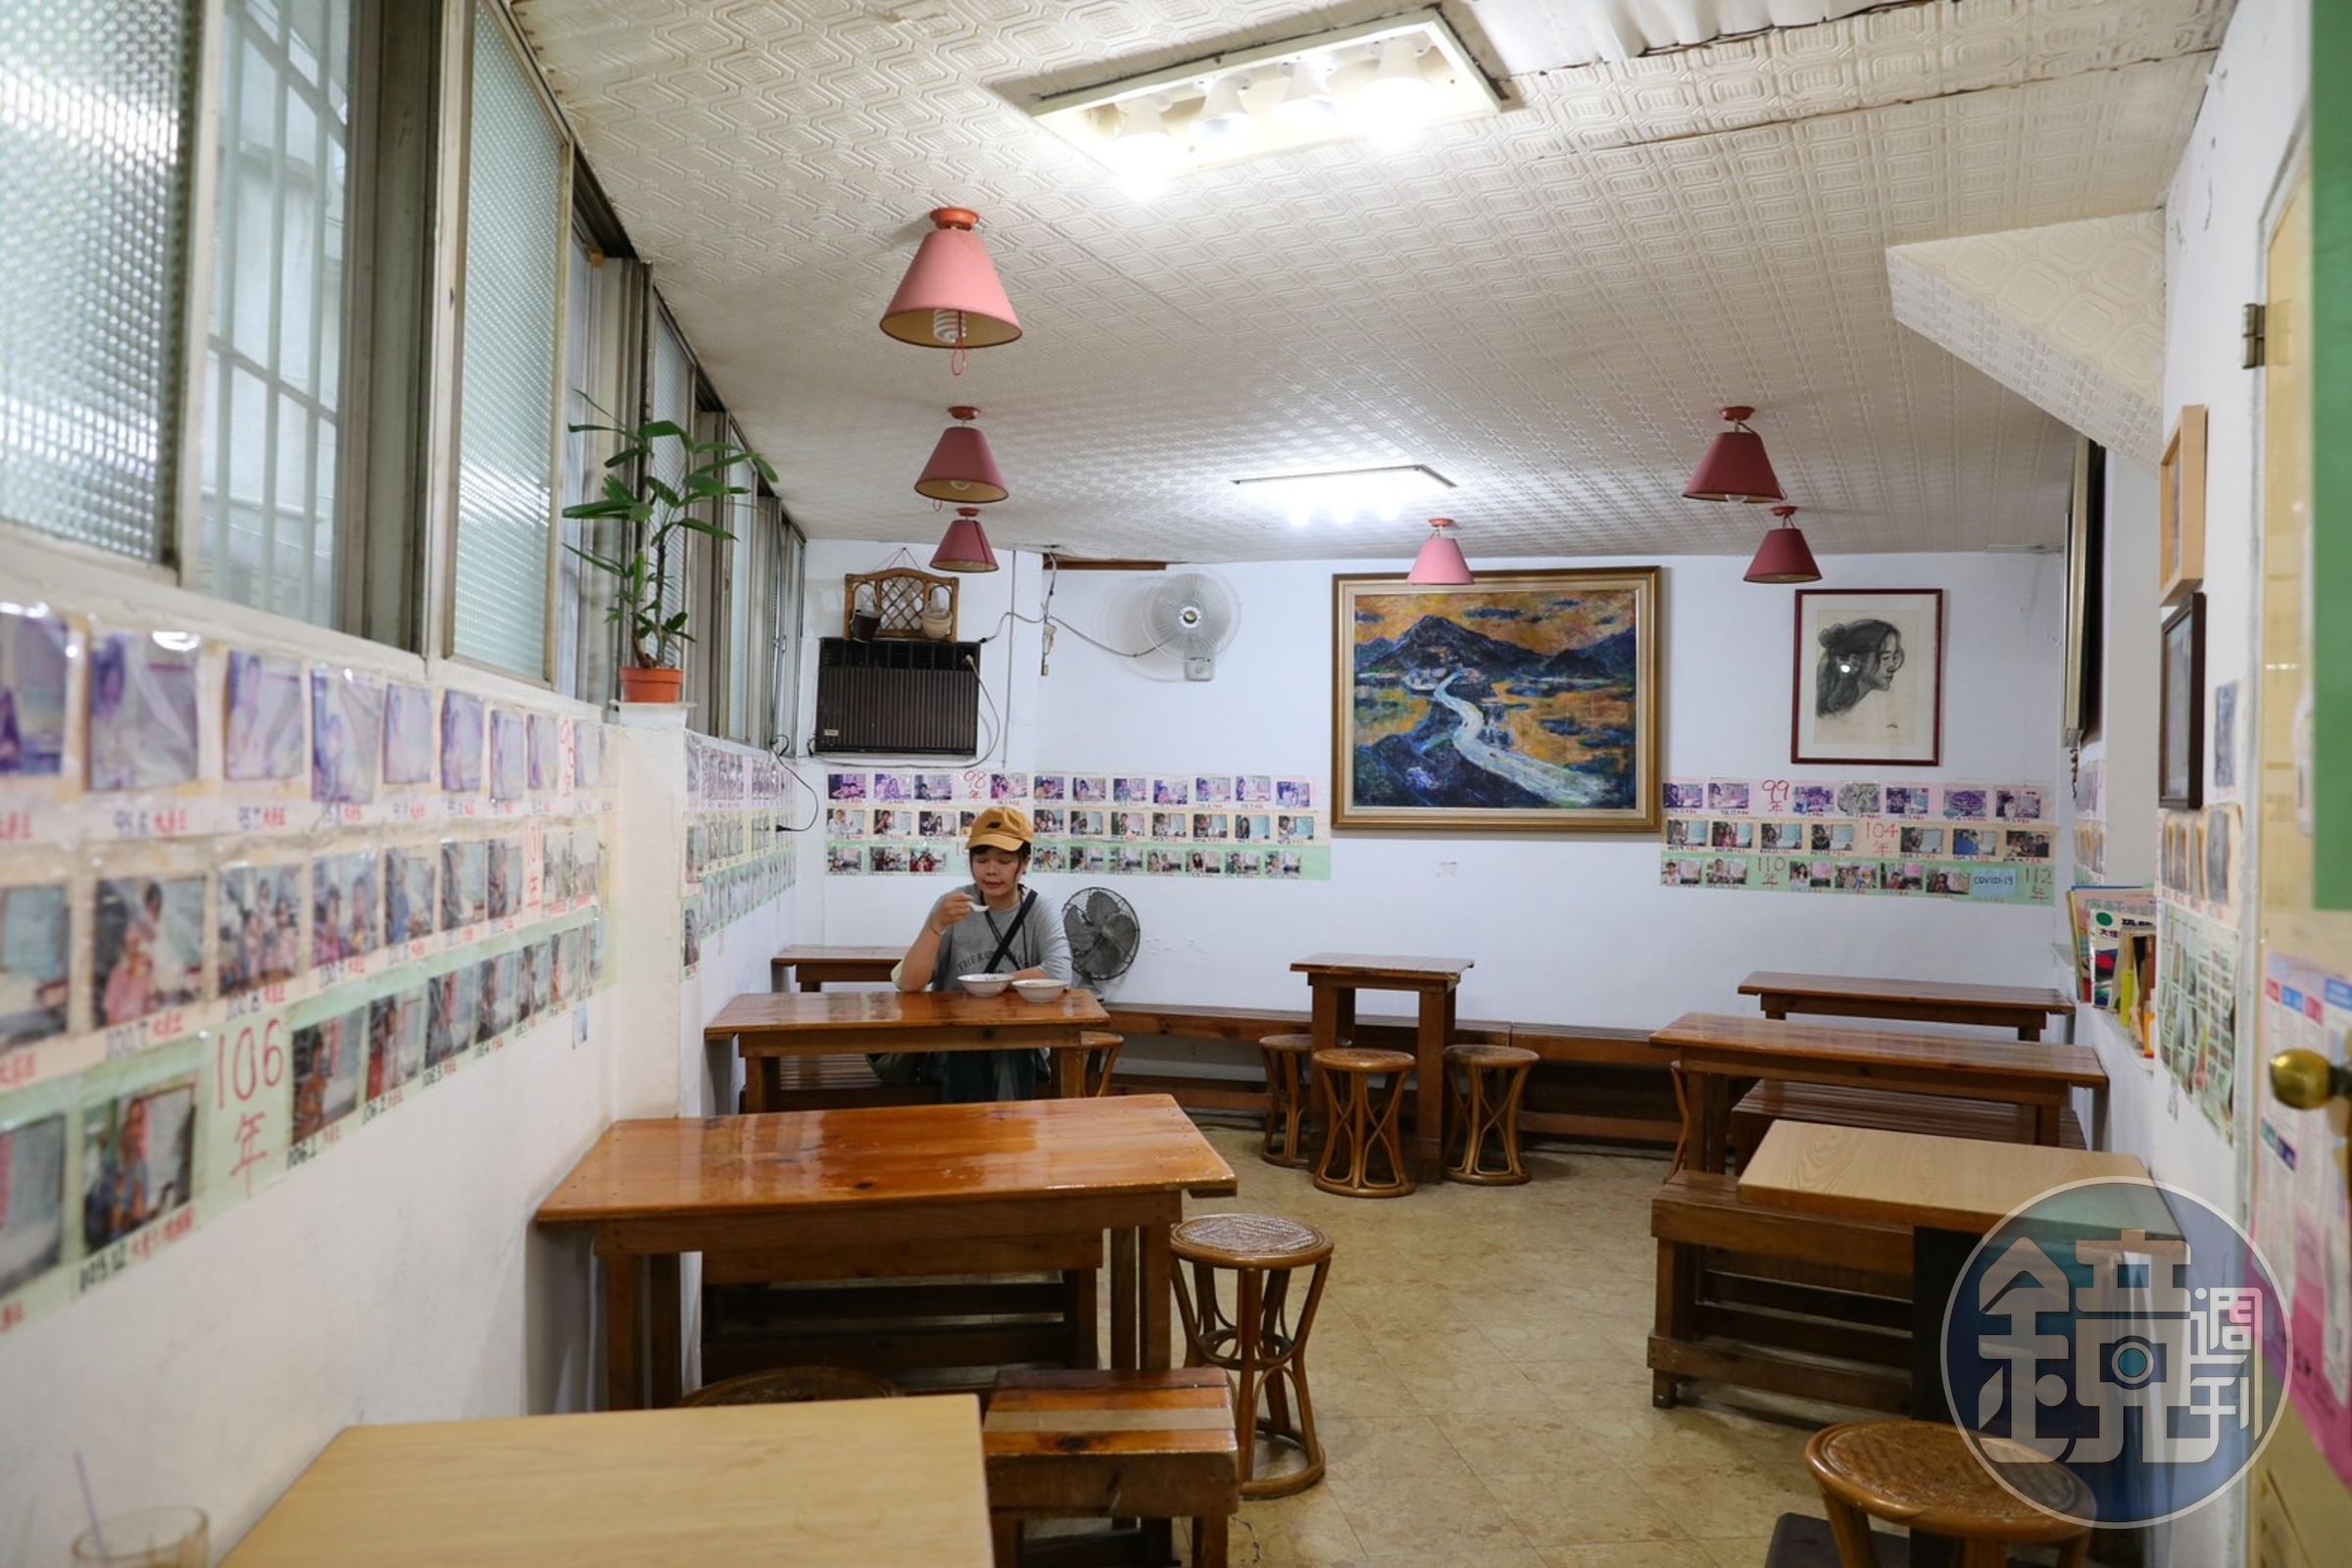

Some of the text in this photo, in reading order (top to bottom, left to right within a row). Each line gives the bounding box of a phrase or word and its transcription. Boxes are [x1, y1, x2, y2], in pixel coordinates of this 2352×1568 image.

[963, 770, 987, 789] 98
[1762, 779, 1789, 802] 99
[1866, 821, 1899, 839] 104
[1758, 857, 1787, 872] 110
[1974, 875, 2015, 887] COVID-19
[2025, 867, 2052, 885] 112
[217, 1017, 285, 1110] 106
[229, 1111, 268, 1200] 年
